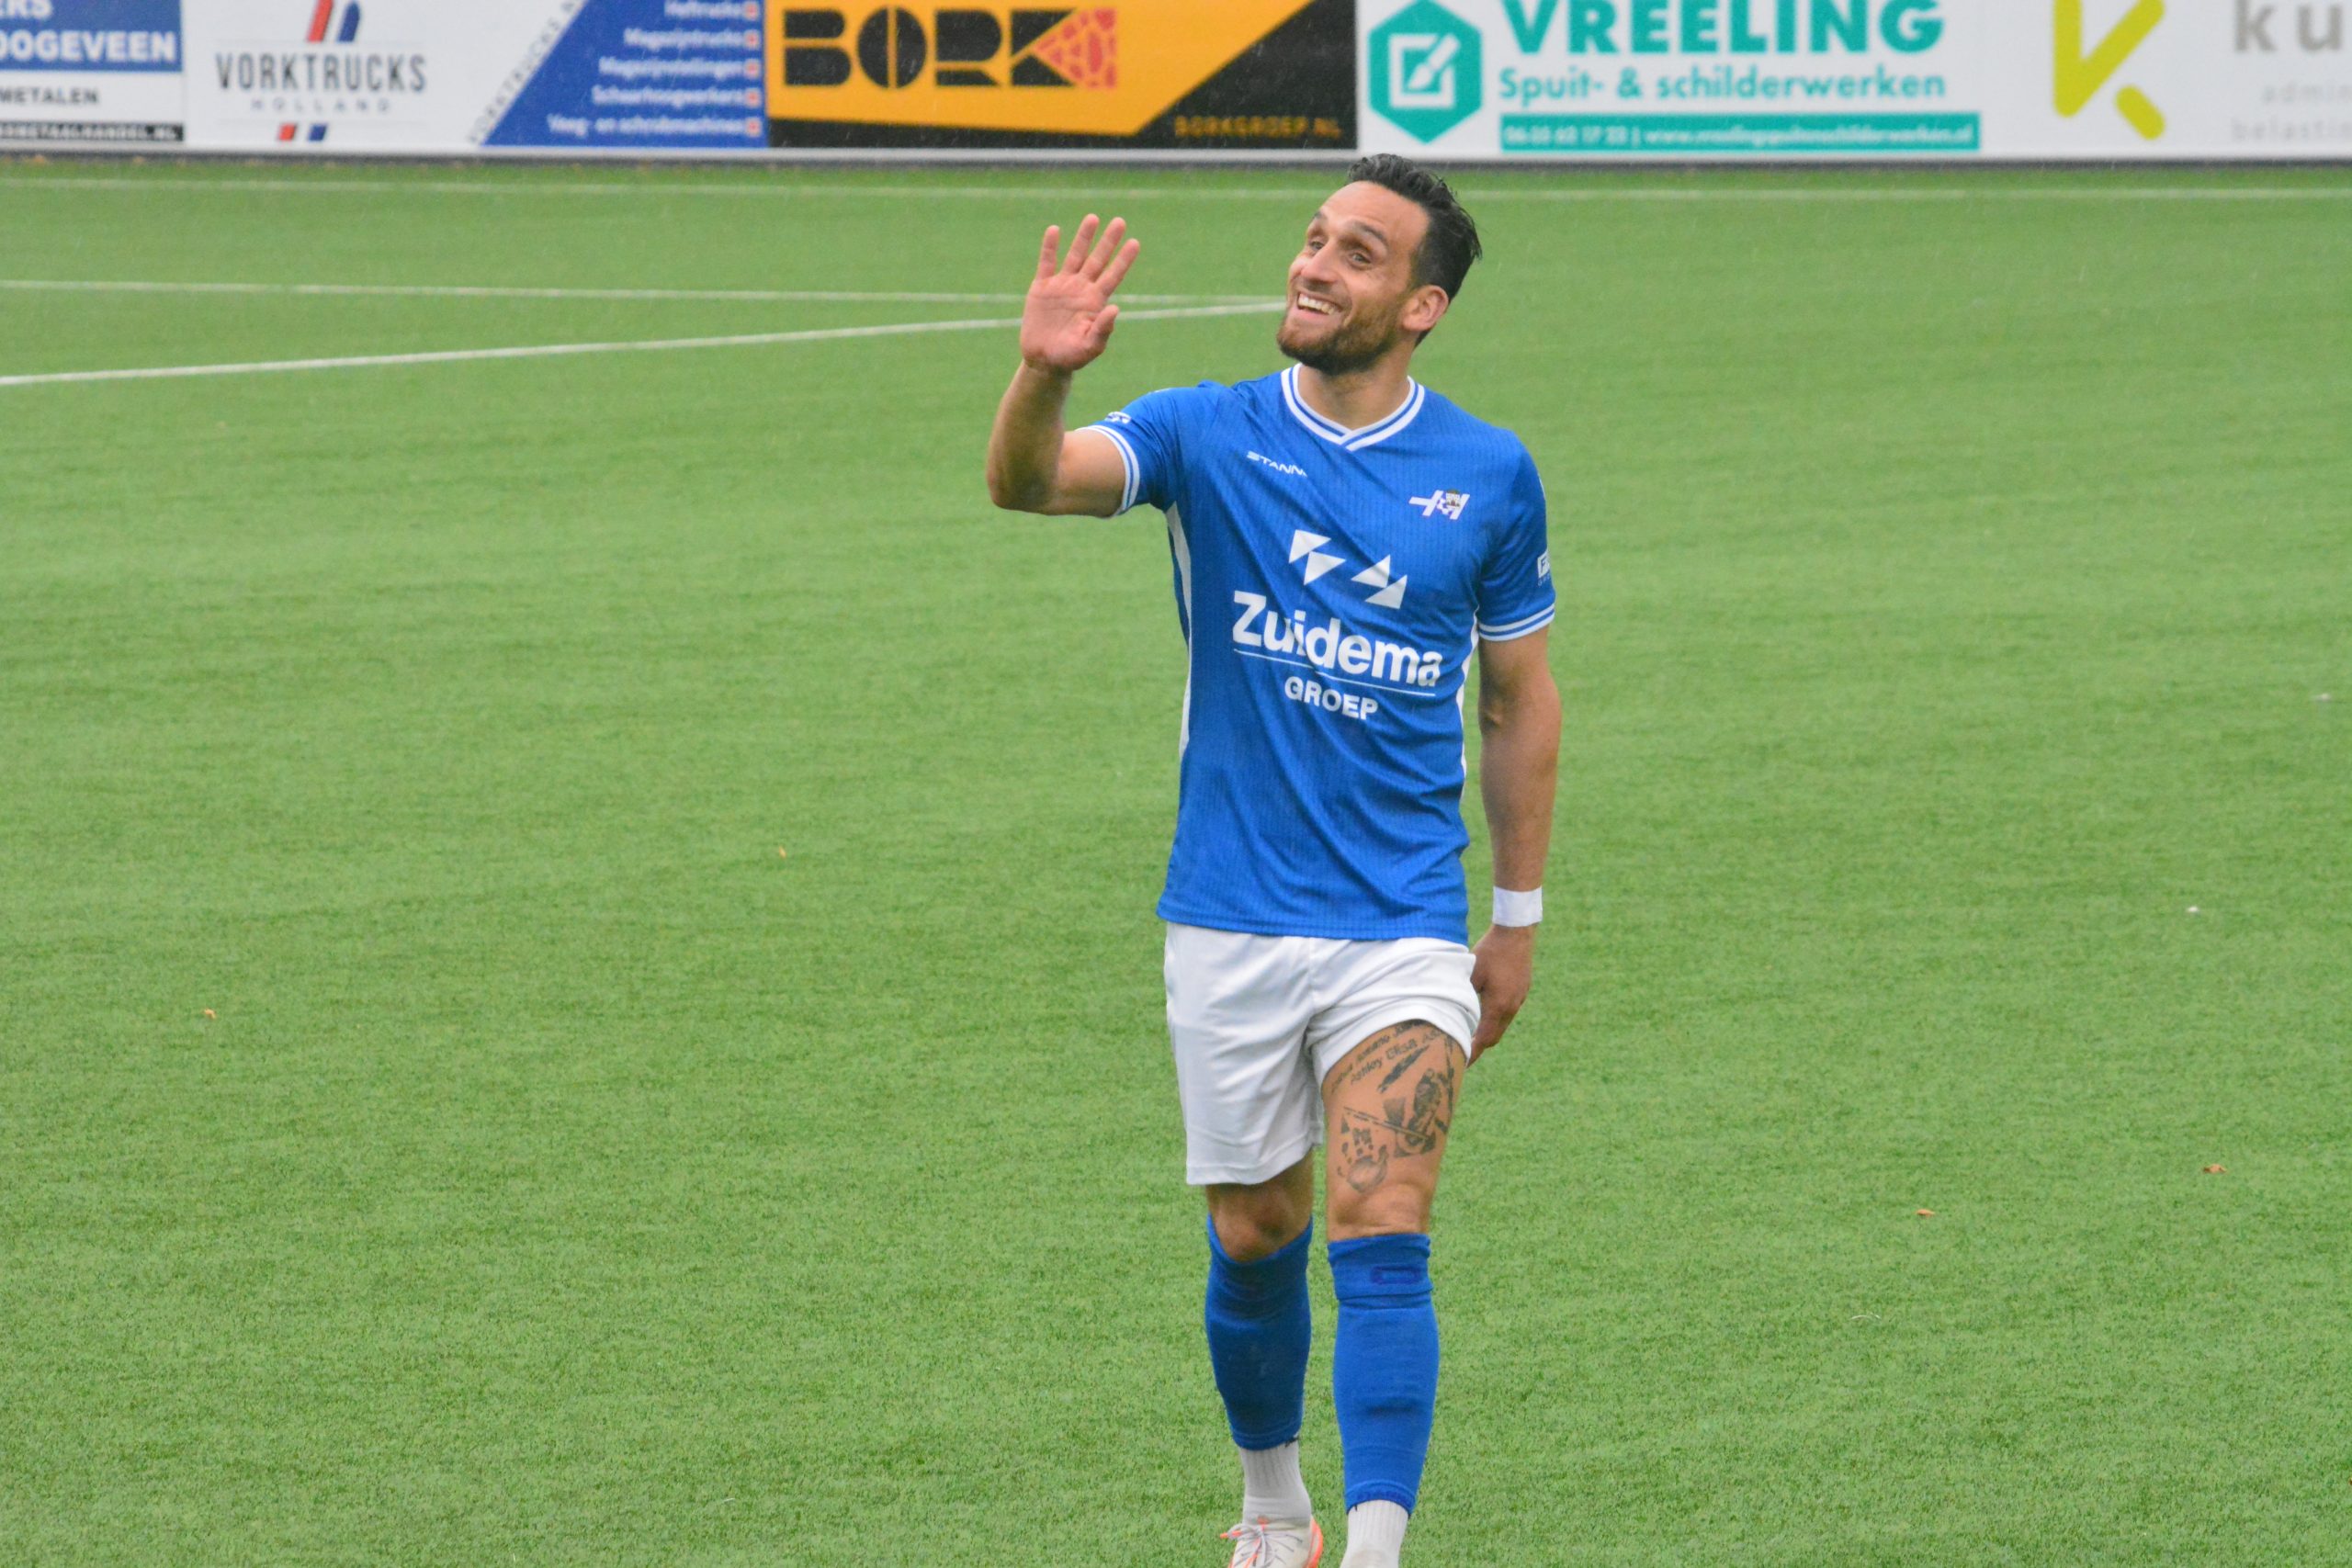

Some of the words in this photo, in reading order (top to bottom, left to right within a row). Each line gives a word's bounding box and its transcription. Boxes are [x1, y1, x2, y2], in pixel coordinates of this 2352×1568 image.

[785, 7, 1077, 89] BORK
[1503, 0, 1944, 53] VREELING
[216, 52, 426, 92] VORKTRUCKS
[1617, 70, 1643, 98] &
[1657, 64, 1946, 99] schilderwerken
[1233, 590, 1443, 688] Zuidema
[1284, 675, 1378, 721] GROEP
